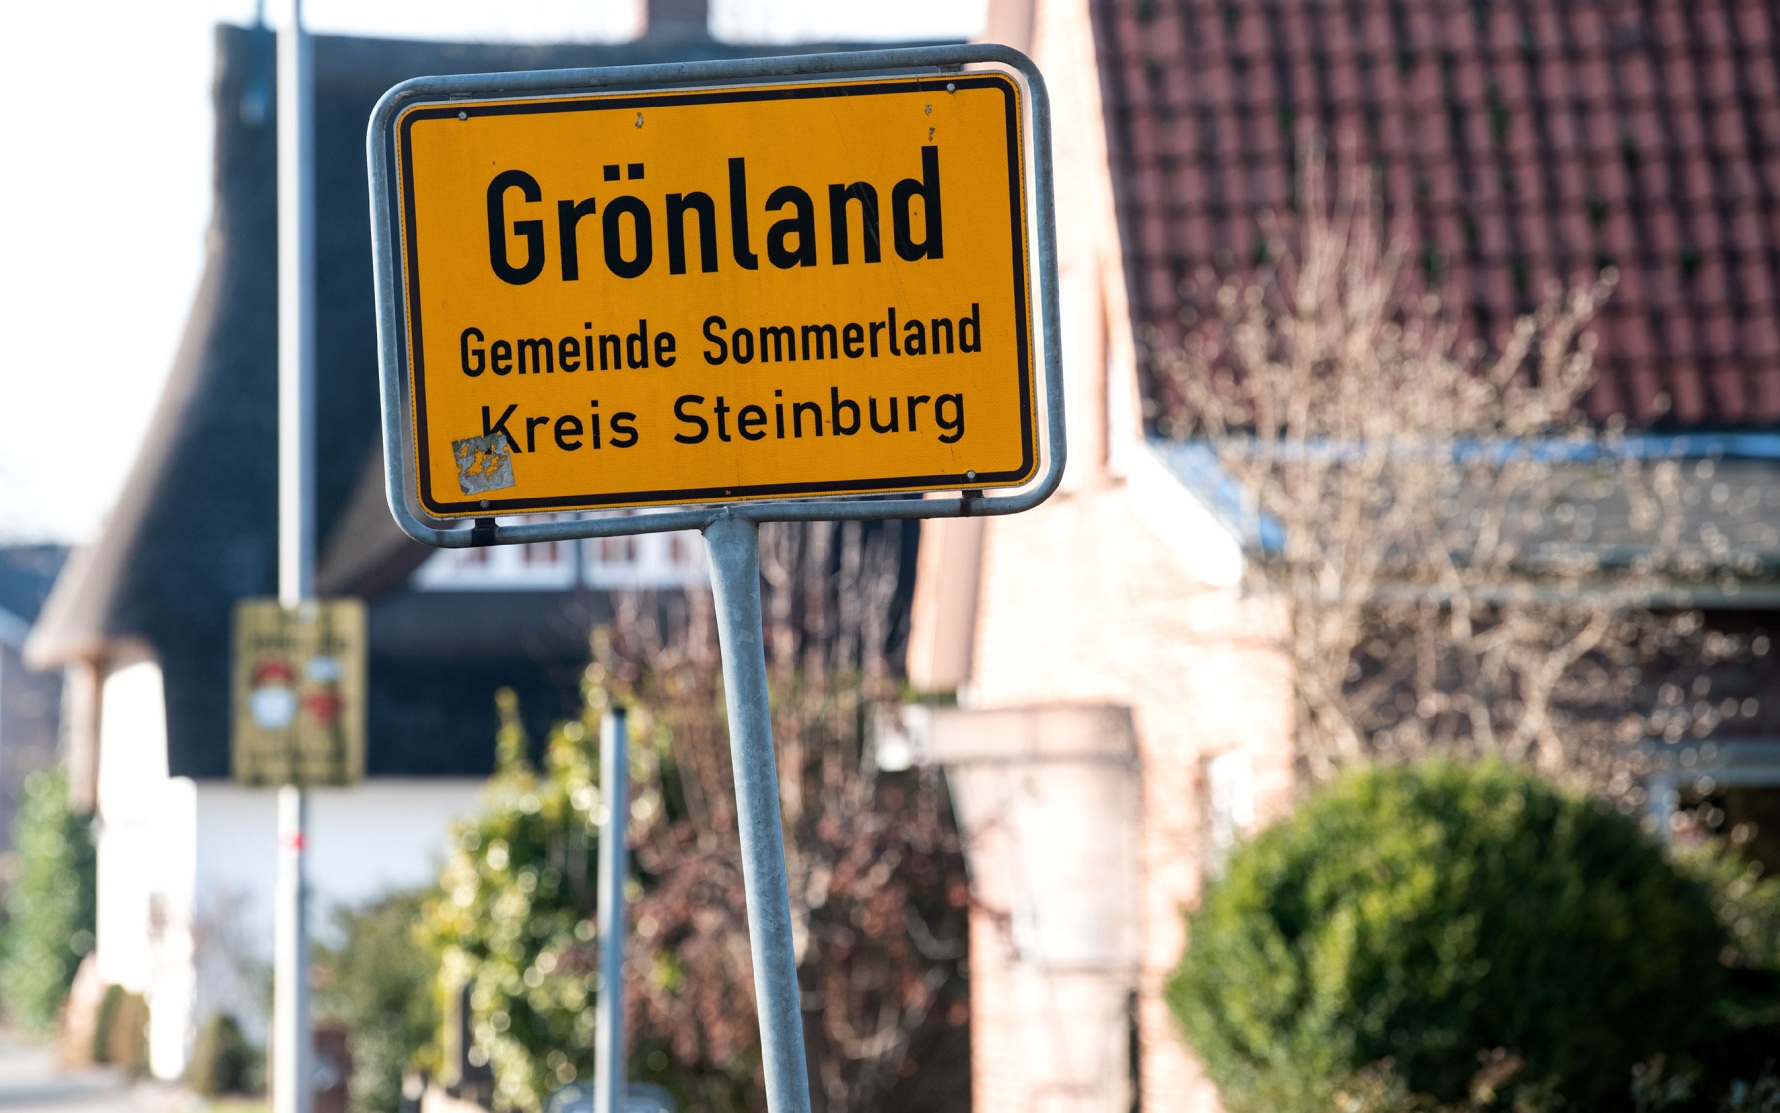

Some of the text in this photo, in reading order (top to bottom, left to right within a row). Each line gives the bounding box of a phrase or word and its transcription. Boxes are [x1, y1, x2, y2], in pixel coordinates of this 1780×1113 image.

[486, 145, 944, 286] Grönland
[460, 302, 982, 378] Gemeinde Sommerland
[481, 386, 965, 454] Kreis Steinburg
